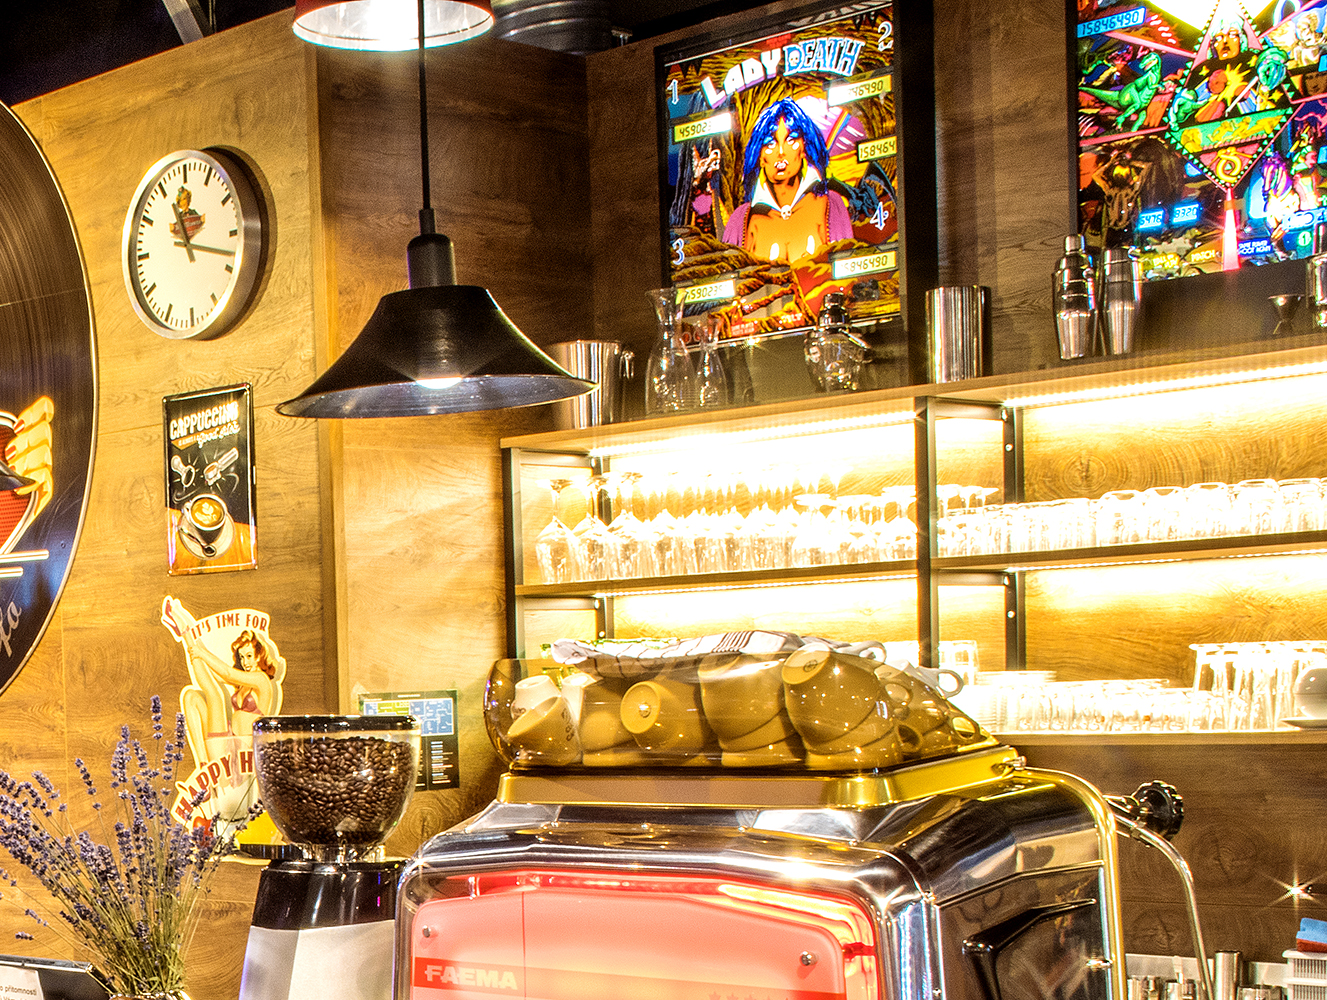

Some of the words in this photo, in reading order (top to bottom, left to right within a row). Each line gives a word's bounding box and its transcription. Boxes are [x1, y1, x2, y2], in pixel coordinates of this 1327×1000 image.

[878, 21, 894, 51] 2
[1082, 11, 1140, 35] 15846490
[701, 49, 782, 109] LADY
[783, 37, 866, 77] DEATH
[870, 201, 889, 230] 4
[672, 237, 685, 266] 3
[170, 400, 239, 440] CAPPUCCINO
[191, 619, 212, 640] IT'S
[215, 612, 241, 629] TIME
[245, 613, 268, 632] FOR
[175, 754, 231, 820] HAPPY
[425, 964, 518, 990] FAEMA
